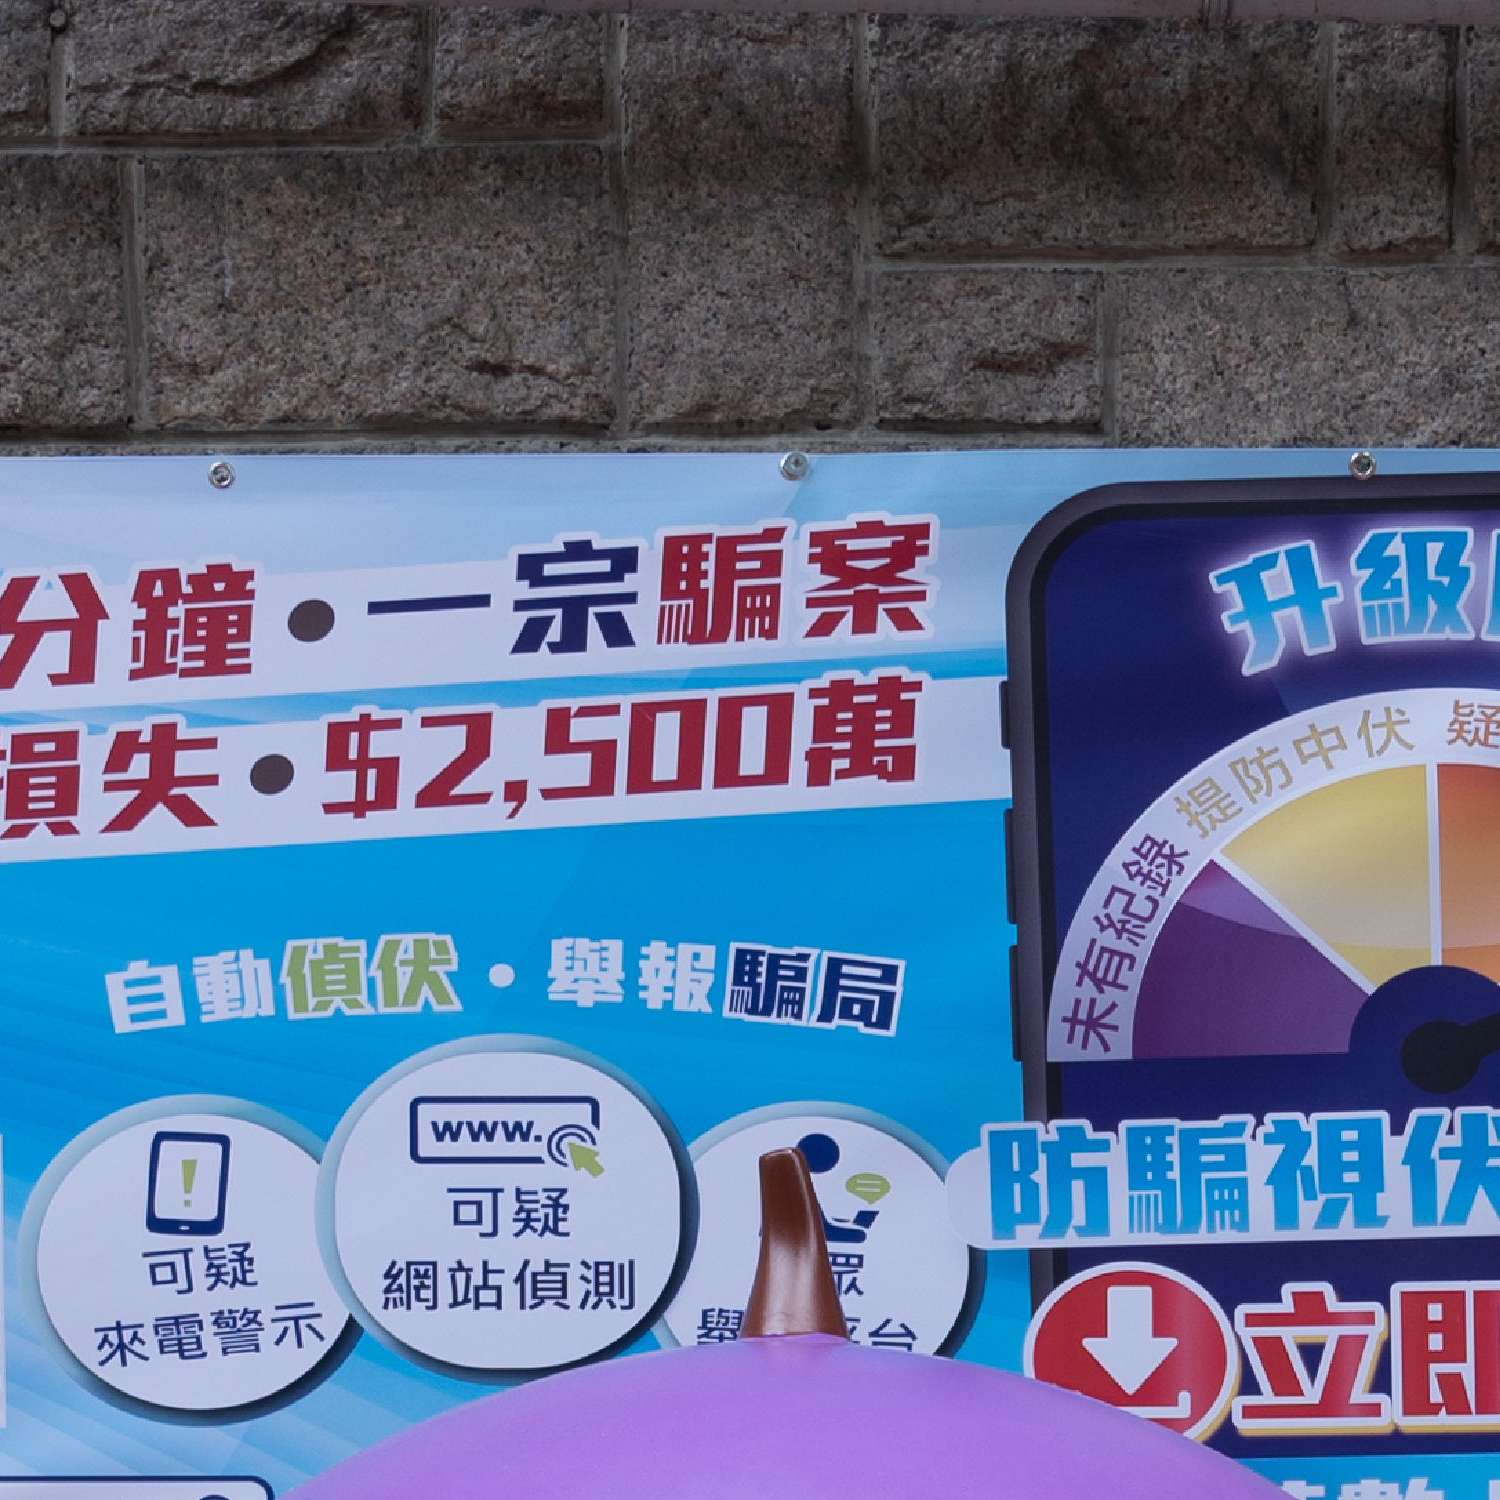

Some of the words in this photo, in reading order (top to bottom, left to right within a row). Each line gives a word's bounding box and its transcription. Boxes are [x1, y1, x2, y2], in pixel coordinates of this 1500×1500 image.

[1061, 834, 1190, 1053] 未有紀錄
[1174, 706, 1414, 839] 提防中伏
[431, 1120, 542, 1143] www.
[447, 1187, 570, 1238] 可疑
[142, 1242, 258, 1294] 可疑
[382, 1259, 636, 1311] 網站偵測
[94, 1302, 326, 1367] 來電警示
